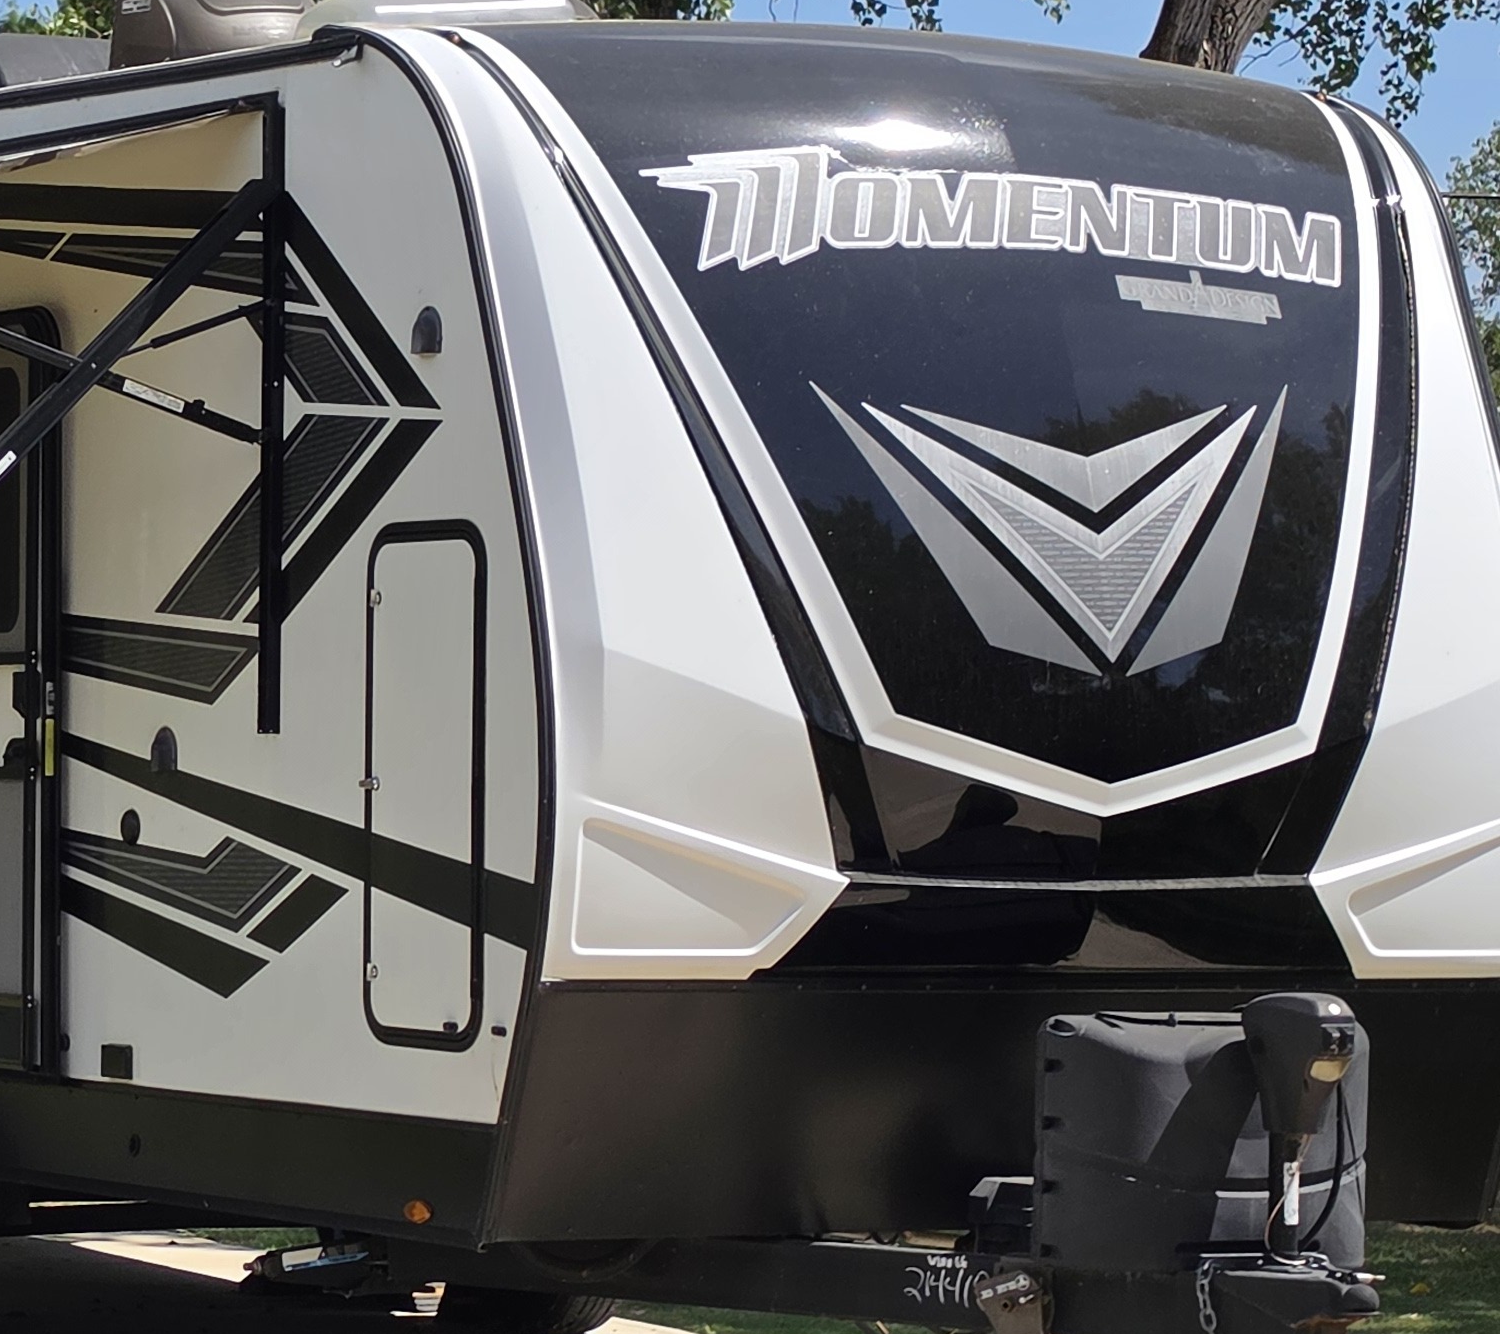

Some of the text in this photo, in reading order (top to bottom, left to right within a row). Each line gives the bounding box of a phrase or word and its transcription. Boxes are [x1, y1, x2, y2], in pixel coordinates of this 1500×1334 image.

[638, 145, 1342, 286] MOMENTUM
[1120, 278, 1277, 314] GRAND DESIGN
